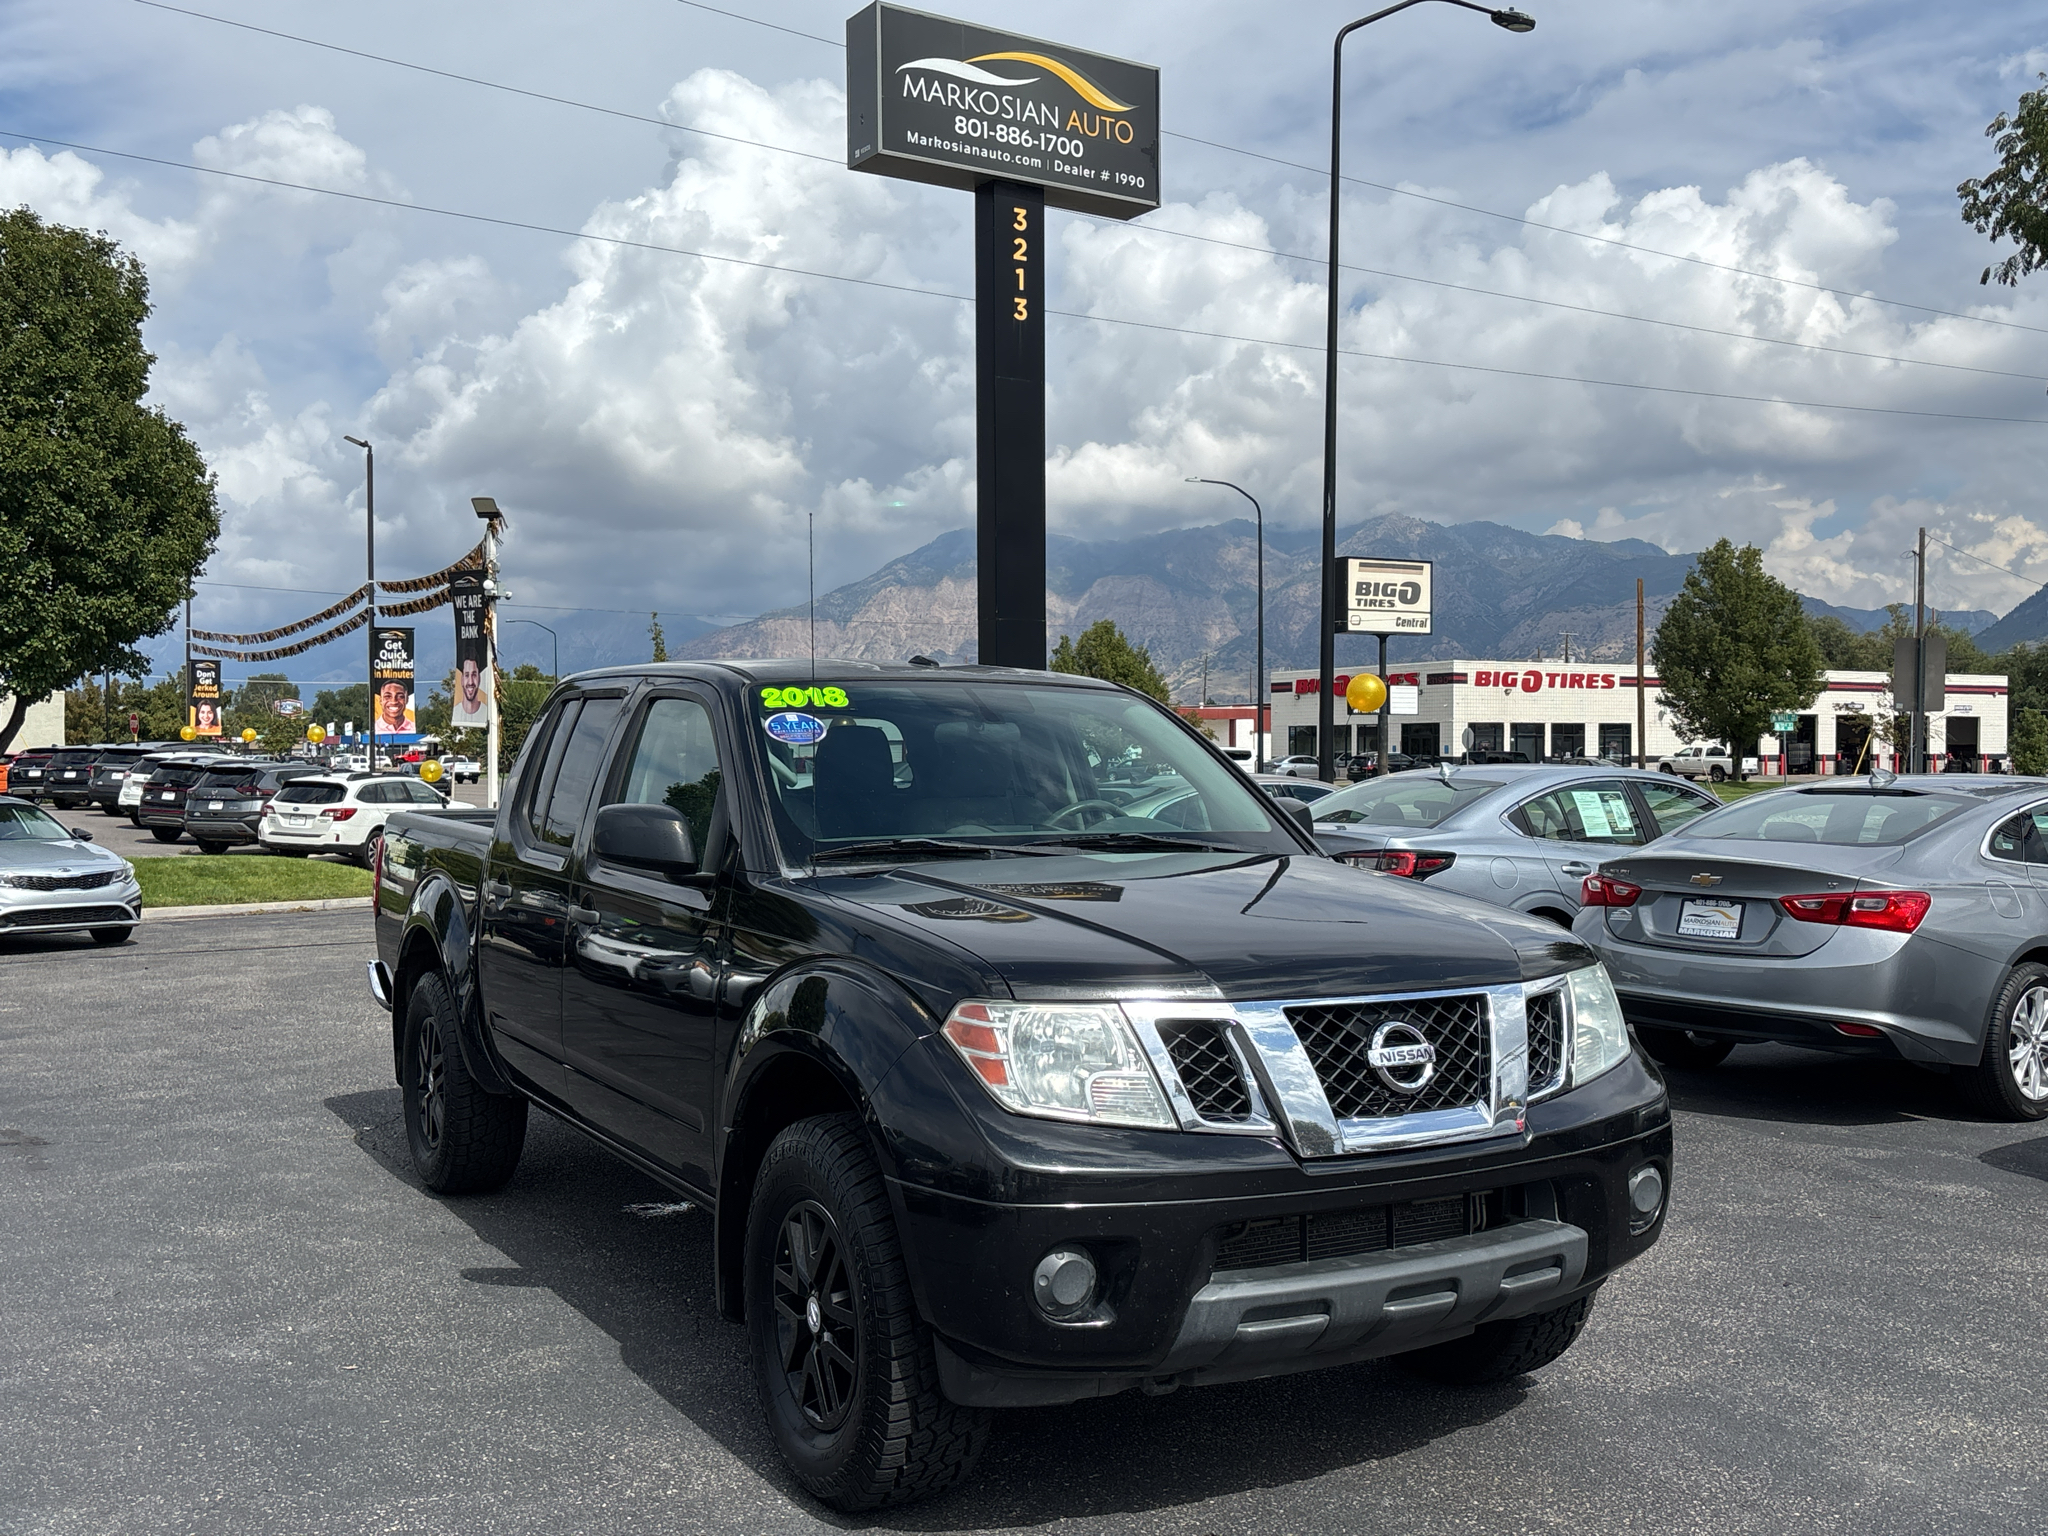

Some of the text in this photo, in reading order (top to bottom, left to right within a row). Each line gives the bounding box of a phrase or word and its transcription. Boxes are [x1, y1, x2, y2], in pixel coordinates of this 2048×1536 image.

[903, 73, 1134, 144] MARKOSIAN AUTO
[954, 116, 1084, 158] 801-886-1700
[906, 130, 1145, 188] Markosianauto.com Dealer # 1990
[1355, 581, 1398, 597] BIG
[454, 594, 482, 608] WE ARE
[1355, 598, 1396, 608] TIRES
[462, 610, 476, 624] THE
[1395, 617, 1429, 628] Central
[461, 626, 479, 639] BANK
[384, 640, 403, 650] Get
[379, 649, 408, 660] Quick
[374, 659, 414, 670] Qualified
[196, 670, 215, 678] Don't
[382, 669, 414, 678] Minutes
[1295, 678, 1320, 694] BI
[1474, 670, 1615, 693] BIG O TIRES
[193, 684, 218, 692] Jerked
[760, 686, 849, 708] 2018
[770, 721, 819, 730] 5 YEAR
[1684, 917, 1720, 926] MARKOSIAN
[1678, 927, 1737, 939] MARKOSIAN
[1379, 1047, 1433, 1063] NISSAN
